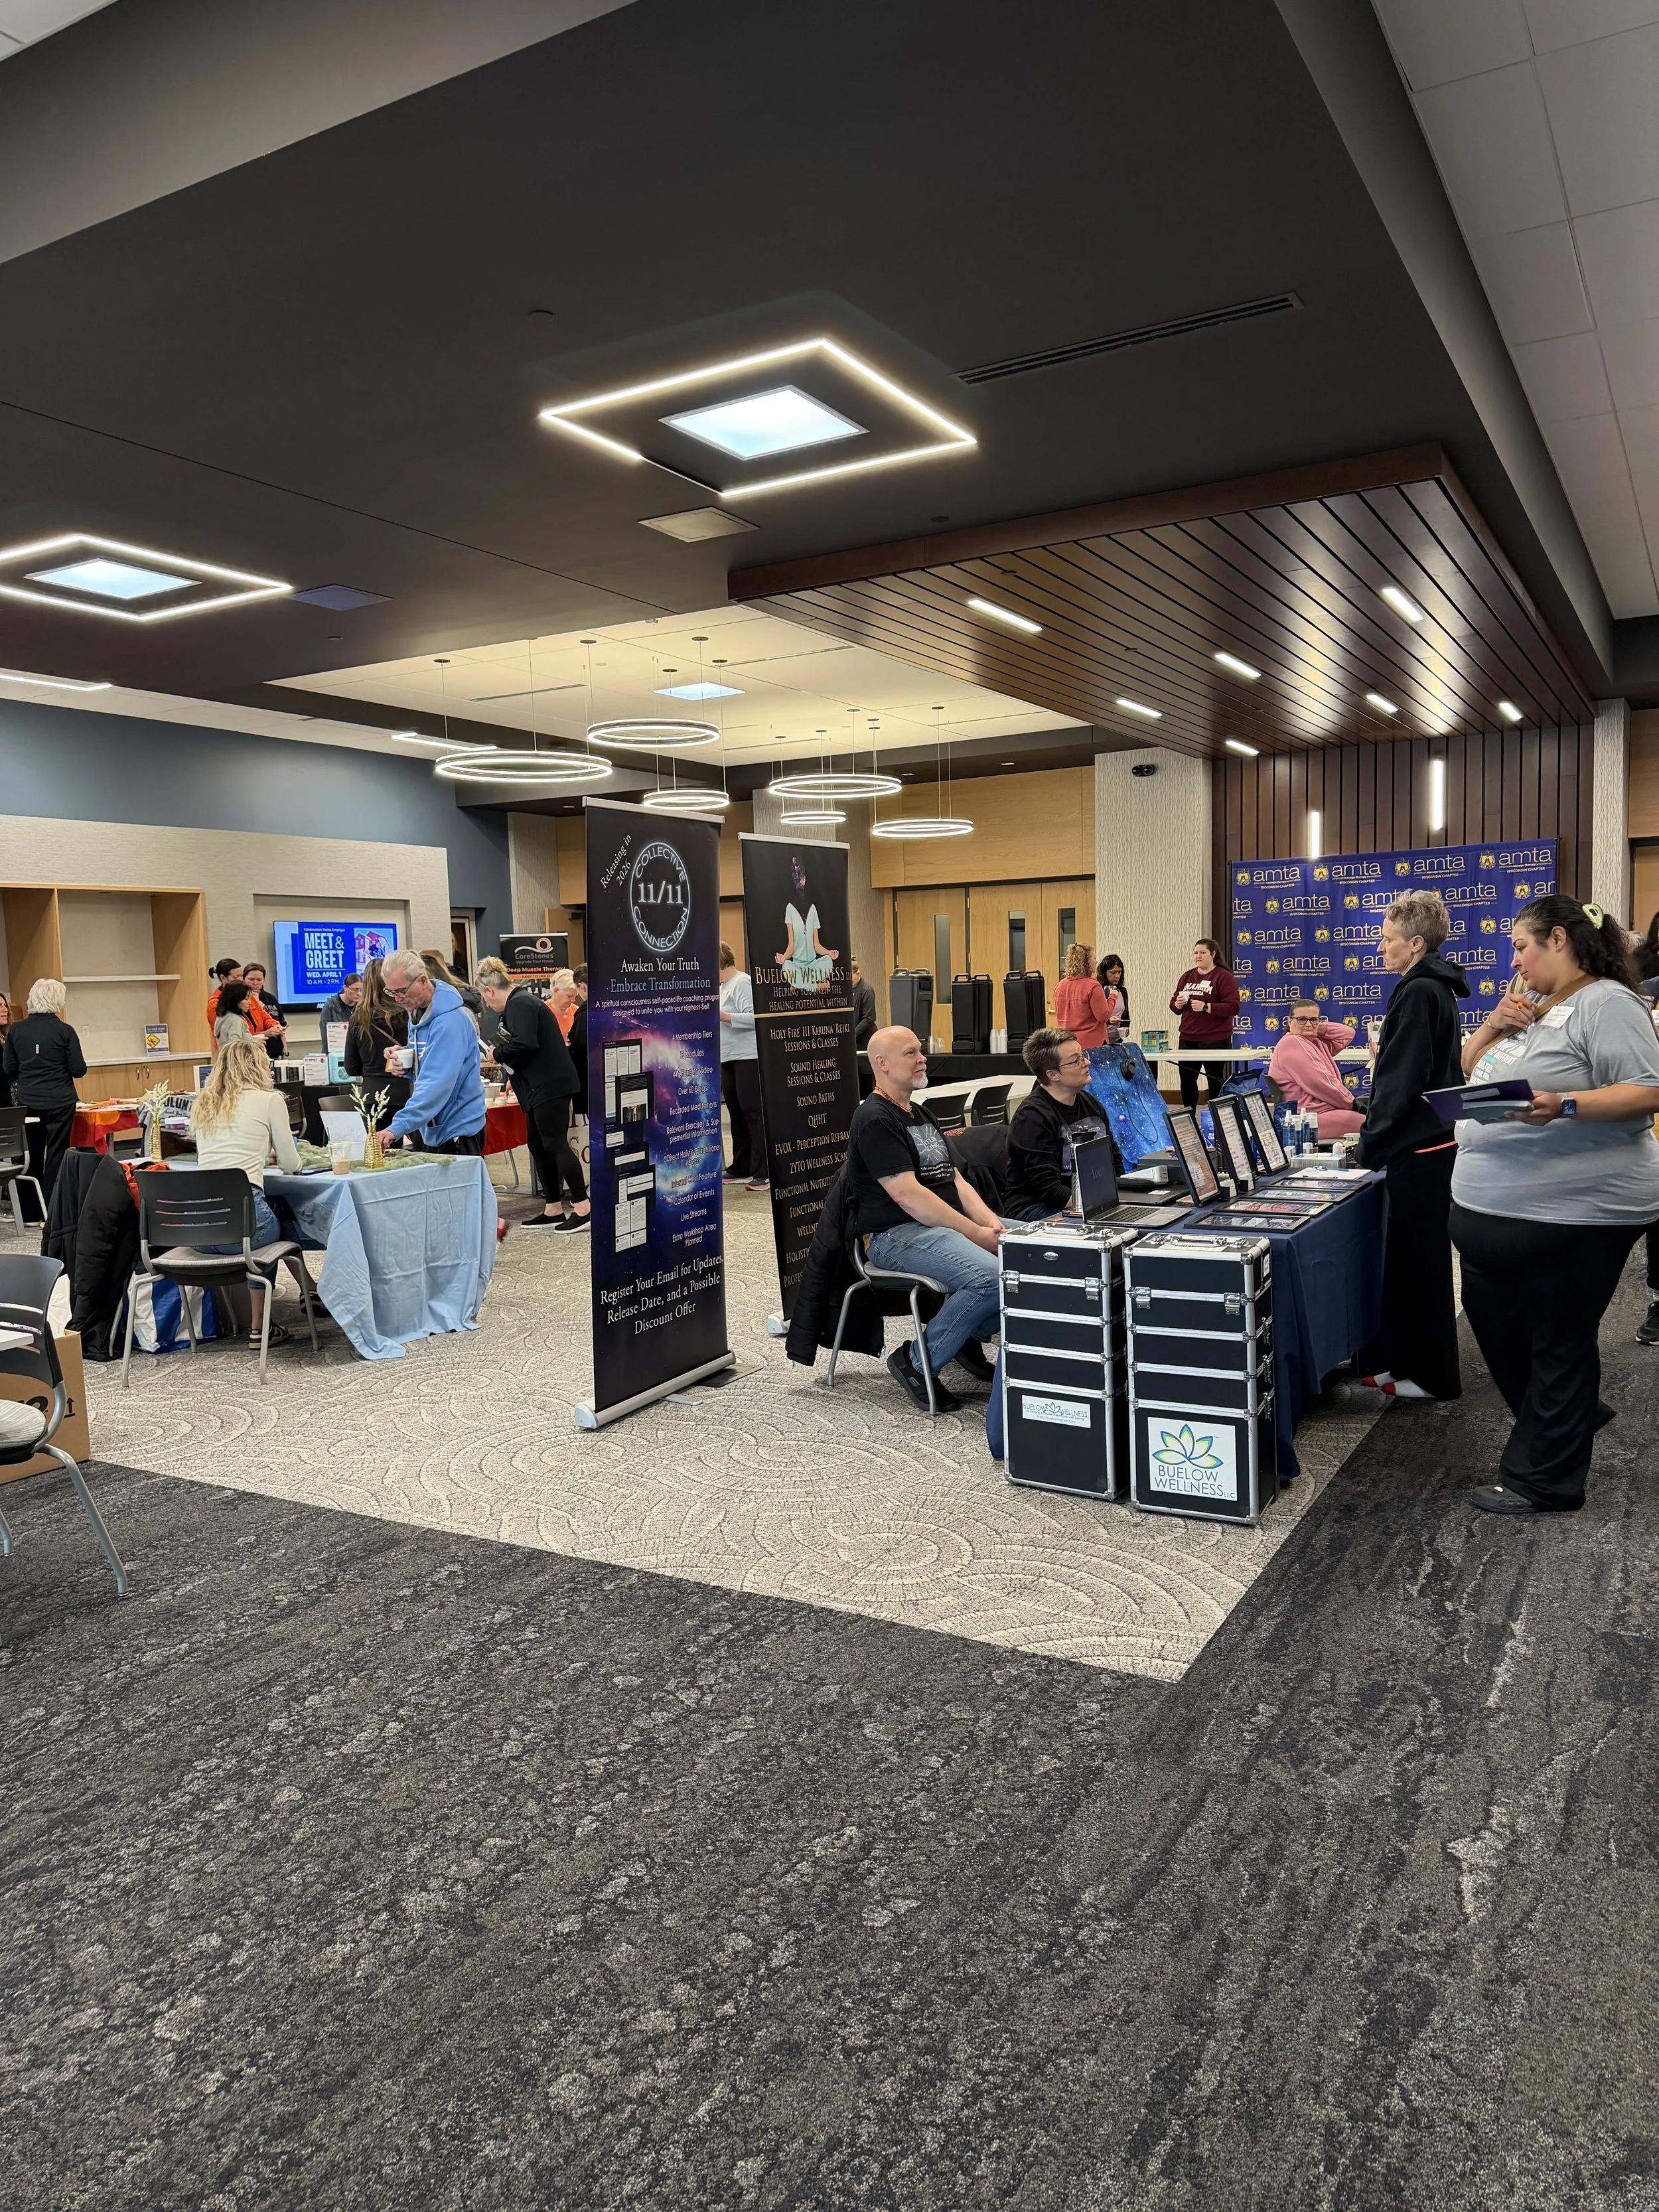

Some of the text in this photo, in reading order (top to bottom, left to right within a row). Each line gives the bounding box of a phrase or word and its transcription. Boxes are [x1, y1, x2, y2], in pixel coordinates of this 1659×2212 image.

[600, 834, 632, 889] Releasing in
[635, 846, 686, 883] COLLECTIVE
[1413, 854, 1466, 871] amta
[1499, 848, 1552, 865] amta
[616, 859, 631, 887] 2026
[1254, 865, 1301, 882] amta
[1332, 861, 1382, 877] amta
[638, 881, 684, 904] 11/11
[1445, 882, 1497, 901] amta
[1232, 897, 1253, 911] ta
[1283, 893, 1331, 913] amta
[633, 905, 688, 948] CONNECTION
[1254, 926, 1301, 942] amta
[1333, 922, 1382, 938] amta
[304, 932, 344, 949] MEET &
[305, 950, 344, 968] GREET
[620, 956, 699, 973] Awaken Your Truth
[1233, 957, 1253, 971] ta
[1283, 954, 1331, 970] amta
[755, 966, 796, 984] BUELOW
[800, 966, 845, 984] WELLNESS
[611, 976, 711, 993] Embrace Transformation
[773, 986, 798, 997] HELPING
[831, 985, 841, 994] THE
[1254, 984, 1301, 999] amta
[1333, 982, 1382, 997] amta
[601, 1000, 619, 1010] spiritual
[620, 998, 652, 1007] consciousness
[652, 996, 676, 1006] self-paced
[683, 994, 704, 1004] coaching
[613, 1008, 634, 1017] designed
[664, 1005, 674, 1013] with
[684, 1002, 710, 1013] Highest-Self
[769, 997, 847, 1011] HEALING POTENTIAL WITHIN
[676, 1031, 701, 1041] Membership
[770, 1029, 786, 1040] HOLY
[835, 1023, 850, 1033] REIKI
[784, 1037, 839, 1053] SESSIONS & CLASSES
[685, 1049, 705, 1059] Modules
[790, 1059, 836, 1073] SOUND HEALING
[787, 1070, 841, 1087] SESSIONS & CLASSES
[694, 1084, 707, 1094] Blogs
[796, 1092, 835, 1107] SOUND BATHS
[669, 1101, 717, 1116] Recorded Meditations
[666, 1124, 685, 1135] Relevant
[685, 1120, 705, 1131] Exercises
[808, 1112, 828, 1128] QHHT
[670, 1127, 717, 1145] plemental Information
[666, 1144, 720, 1162] Direct Holistic Practitioner
[775, 1141, 792, 1156] EVOX
[797, 1134, 830, 1151] PERCEPTION
[790, 1151, 848, 1174] ZYTO WELLNESS SCAN
[699, 1171, 717, 1180] Feature
[674, 1188, 715, 1206] Calendar of Events
[775, 1183, 809, 1200] FUNCTIONAL
[681, 1208, 707, 1222] Live Streams
[790, 1199, 824, 1218] FUNCTIONAL
[672, 1223, 717, 1242] Extra Workshop Area
[797, 1222, 819, 1238] WELLNE
[685, 1234, 703, 1247] Planned
[601, 1284, 634, 1305] Register
[636, 1276, 654, 1292] Your
[657, 1267, 679, 1286] Email
[680, 1261, 691, 1276] for
[607, 1303, 638, 1325] Release
[641, 1294, 664, 1313] Date,
[666, 1284, 682, 1303] and
[690, 1272, 721, 1294] Possible
[634, 1301, 696, 1335] Discount Offer
[1159, 1465, 1218, 1483] BUELOW
[1154, 1477, 1224, 1497] WELLNESS
